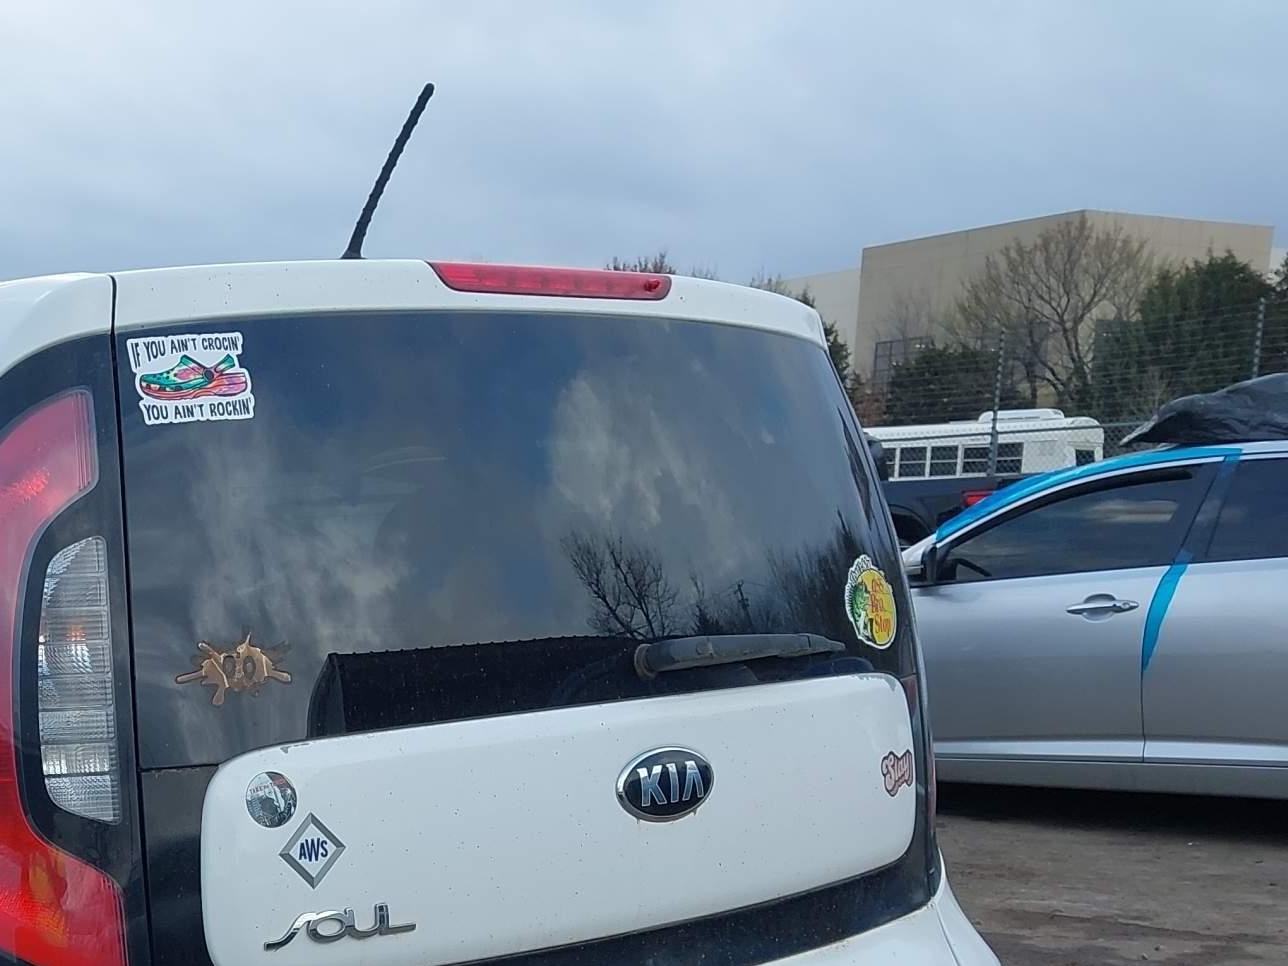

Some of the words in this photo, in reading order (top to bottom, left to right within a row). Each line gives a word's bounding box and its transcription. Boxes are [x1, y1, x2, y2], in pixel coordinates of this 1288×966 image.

[130, 341, 141, 369] IF
[143, 340, 166, 362] YOU
[170, 337, 197, 354] AIN'T
[201, 335, 240, 352] CROCIN'
[143, 403, 169, 421] YOU
[174, 403, 204, 420] AIN'T
[209, 397, 252, 417] ROCKIN'
[636, 760, 705, 807] KIA
[298, 837, 329, 862] AWS
[263, 901, 416, 952] SOUL
